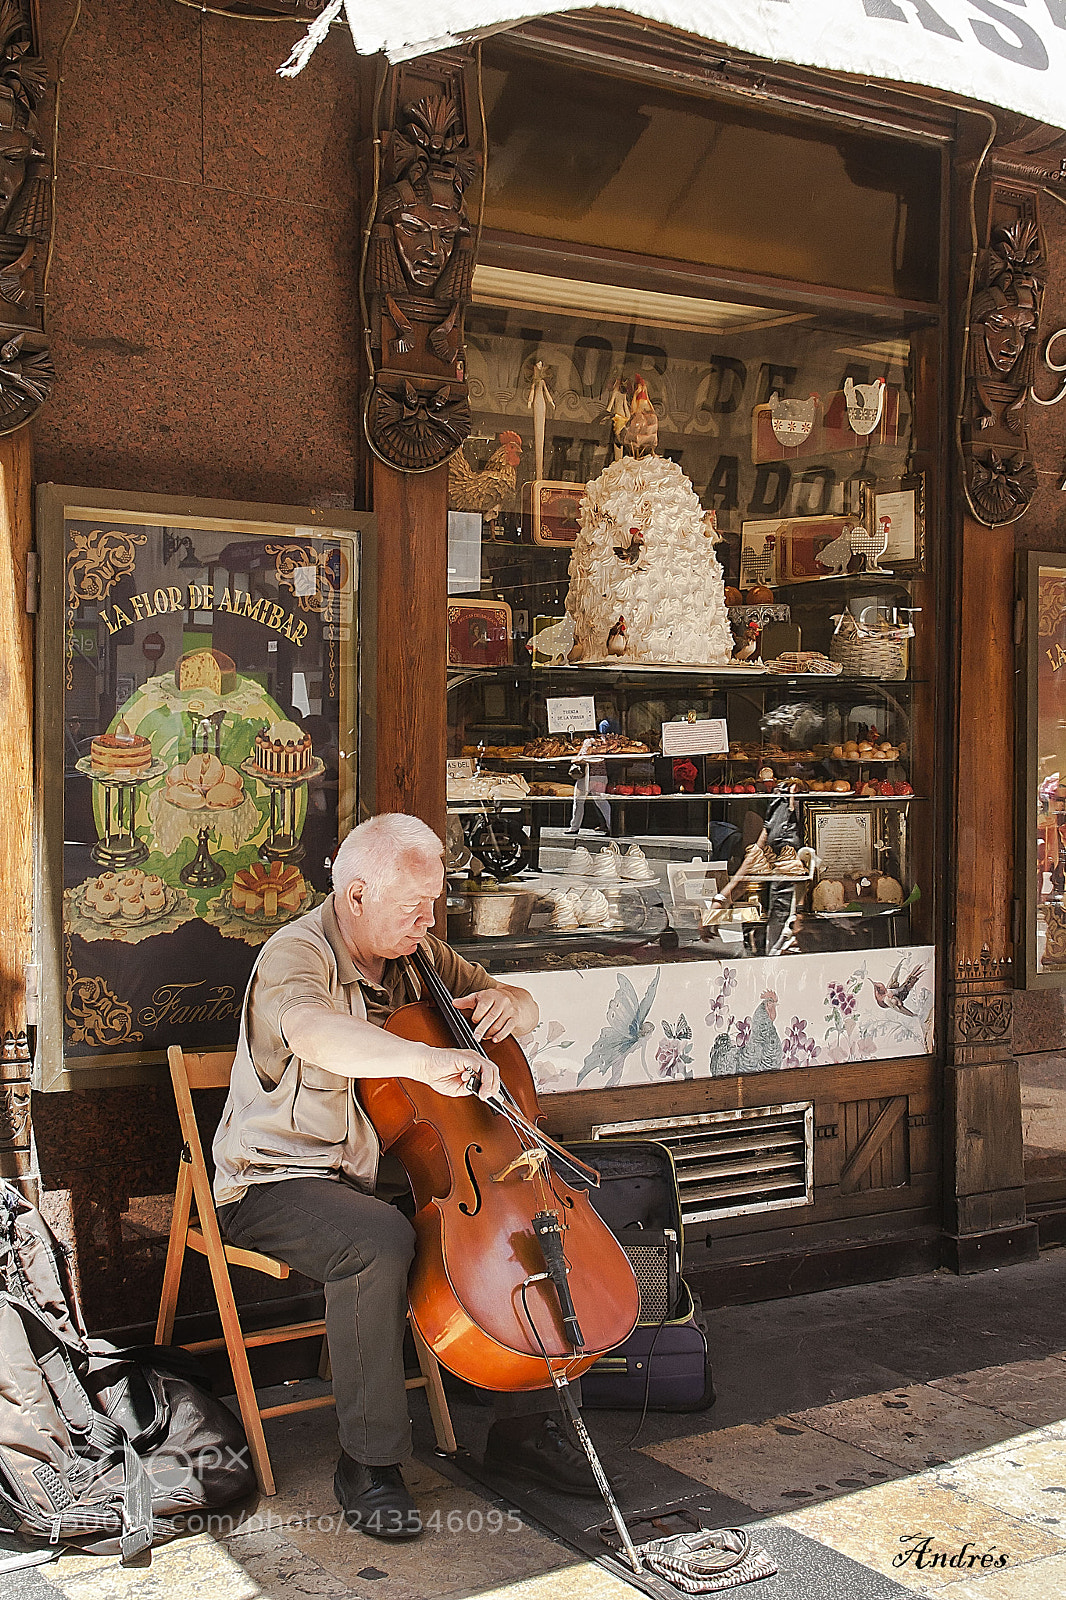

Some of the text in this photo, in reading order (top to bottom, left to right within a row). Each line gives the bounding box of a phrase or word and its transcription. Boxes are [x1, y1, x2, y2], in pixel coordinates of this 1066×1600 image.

[98, 604, 134, 636] LA
[129, 586, 185, 622] FLOR
[188, 584, 215, 611] DE
[217, 587, 309, 647] ALMIBAR
[457, 761, 470, 769] DEL
